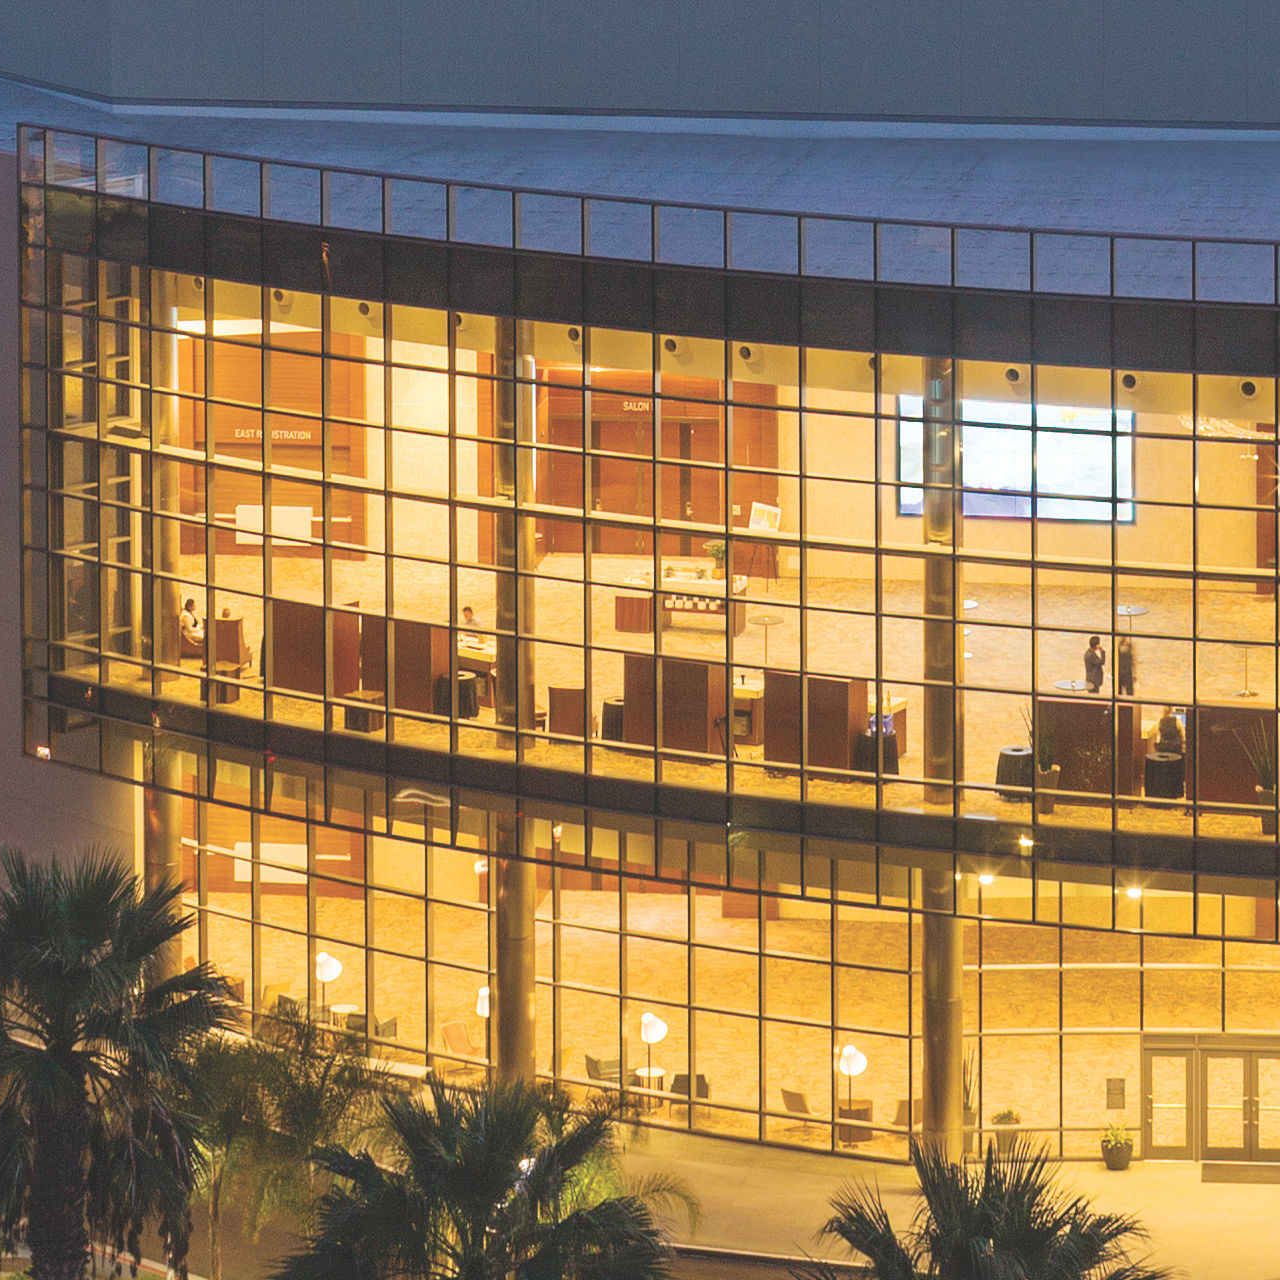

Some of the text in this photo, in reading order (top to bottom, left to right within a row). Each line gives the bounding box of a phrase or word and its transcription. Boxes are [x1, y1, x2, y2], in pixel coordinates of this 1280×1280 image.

[623, 401, 649, 411] SALON
[235, 429, 311, 440] EAST RISTRATION
